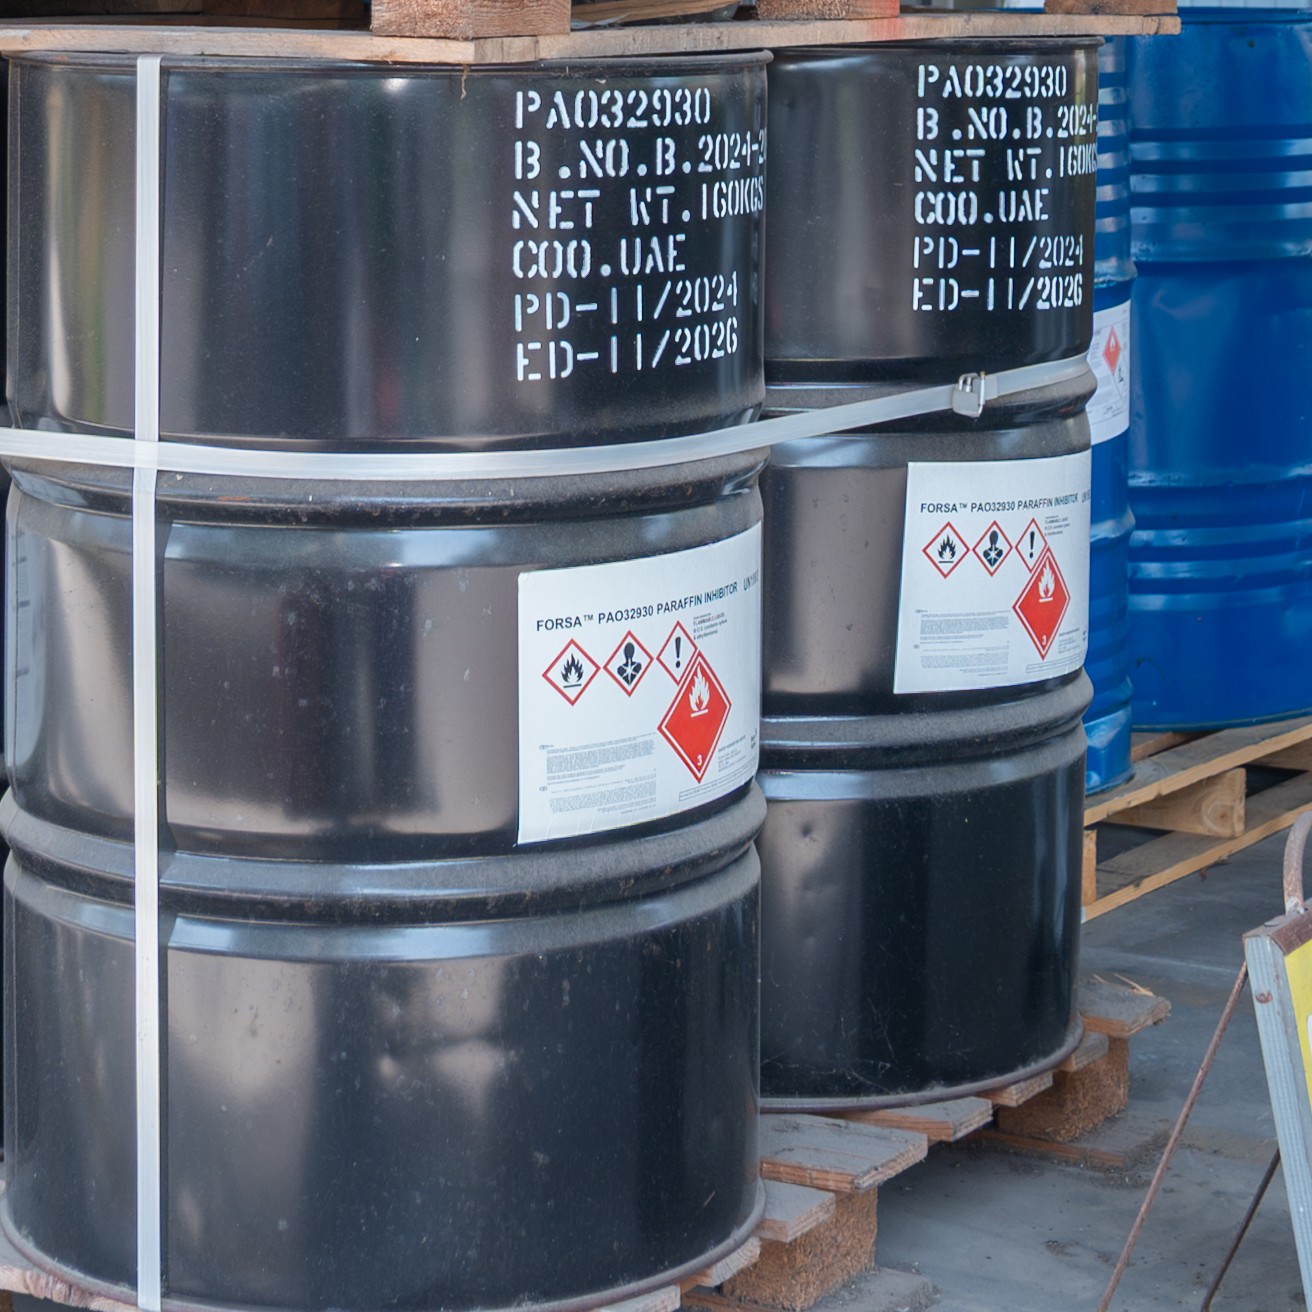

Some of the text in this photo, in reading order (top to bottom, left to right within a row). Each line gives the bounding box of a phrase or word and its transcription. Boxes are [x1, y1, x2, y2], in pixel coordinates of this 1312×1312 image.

[915, 148, 985, 182] NET
[512, 189, 600, 229] NET
[914, 188, 1049, 225] COO.UAE
[512, 234, 685, 279] COO.UAE
[913, 235, 1083, 269] PD-11/2024
[515, 271, 737, 332] PD-11/2024
[913, 273, 1082, 311] ED-11/2026
[516, 317, 738, 382] ED-11/2026
[970, 501, 1015, 513] PAO32930
[1018, 497, 1053, 511] PARAFFIN
[598, 605, 654, 624] PAO32930
[657, 595, 703, 615] PARAFFIN
[704, 581, 738, 603] INHIBITOR
[697, 755, 702, 766] 3
